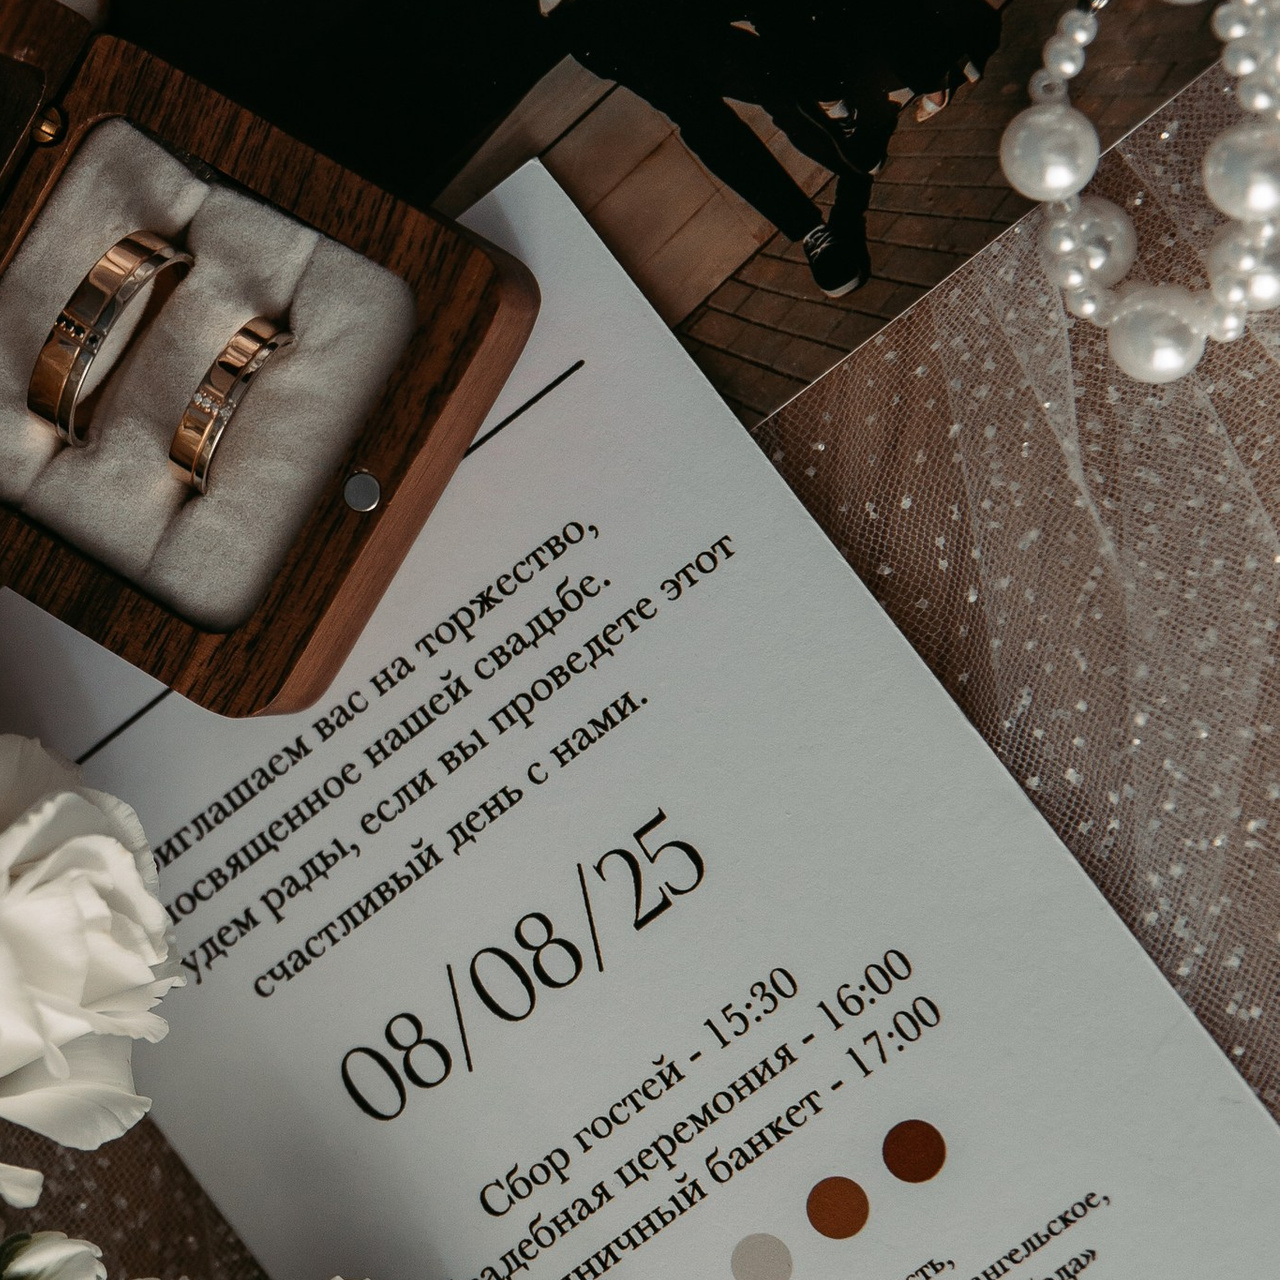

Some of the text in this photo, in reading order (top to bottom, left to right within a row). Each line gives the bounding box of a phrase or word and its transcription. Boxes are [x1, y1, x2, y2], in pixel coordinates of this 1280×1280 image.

[151, 521, 600, 876] иглашаем вас на торжество,
[179, 534, 736, 986] удем рады, если вы проведете этот
[362, 668, 473, 769] нашей
[474, 575, 612, 681] свадьбе.
[253, 690, 649, 998] счастливый день с нами.
[340, 806, 705, 1122] 08/08/25
[479, 1147, 571, 1218] Сбор
[572, 1053, 687, 1154] гостей
[702, 967, 798, 1050] 15:30
[613, 1042, 799, 1189] церемония
[816, 948, 913, 1032] 16:00
[704, 1089, 824, 1184] банкет
[845, 995, 941, 1079] 17:00
